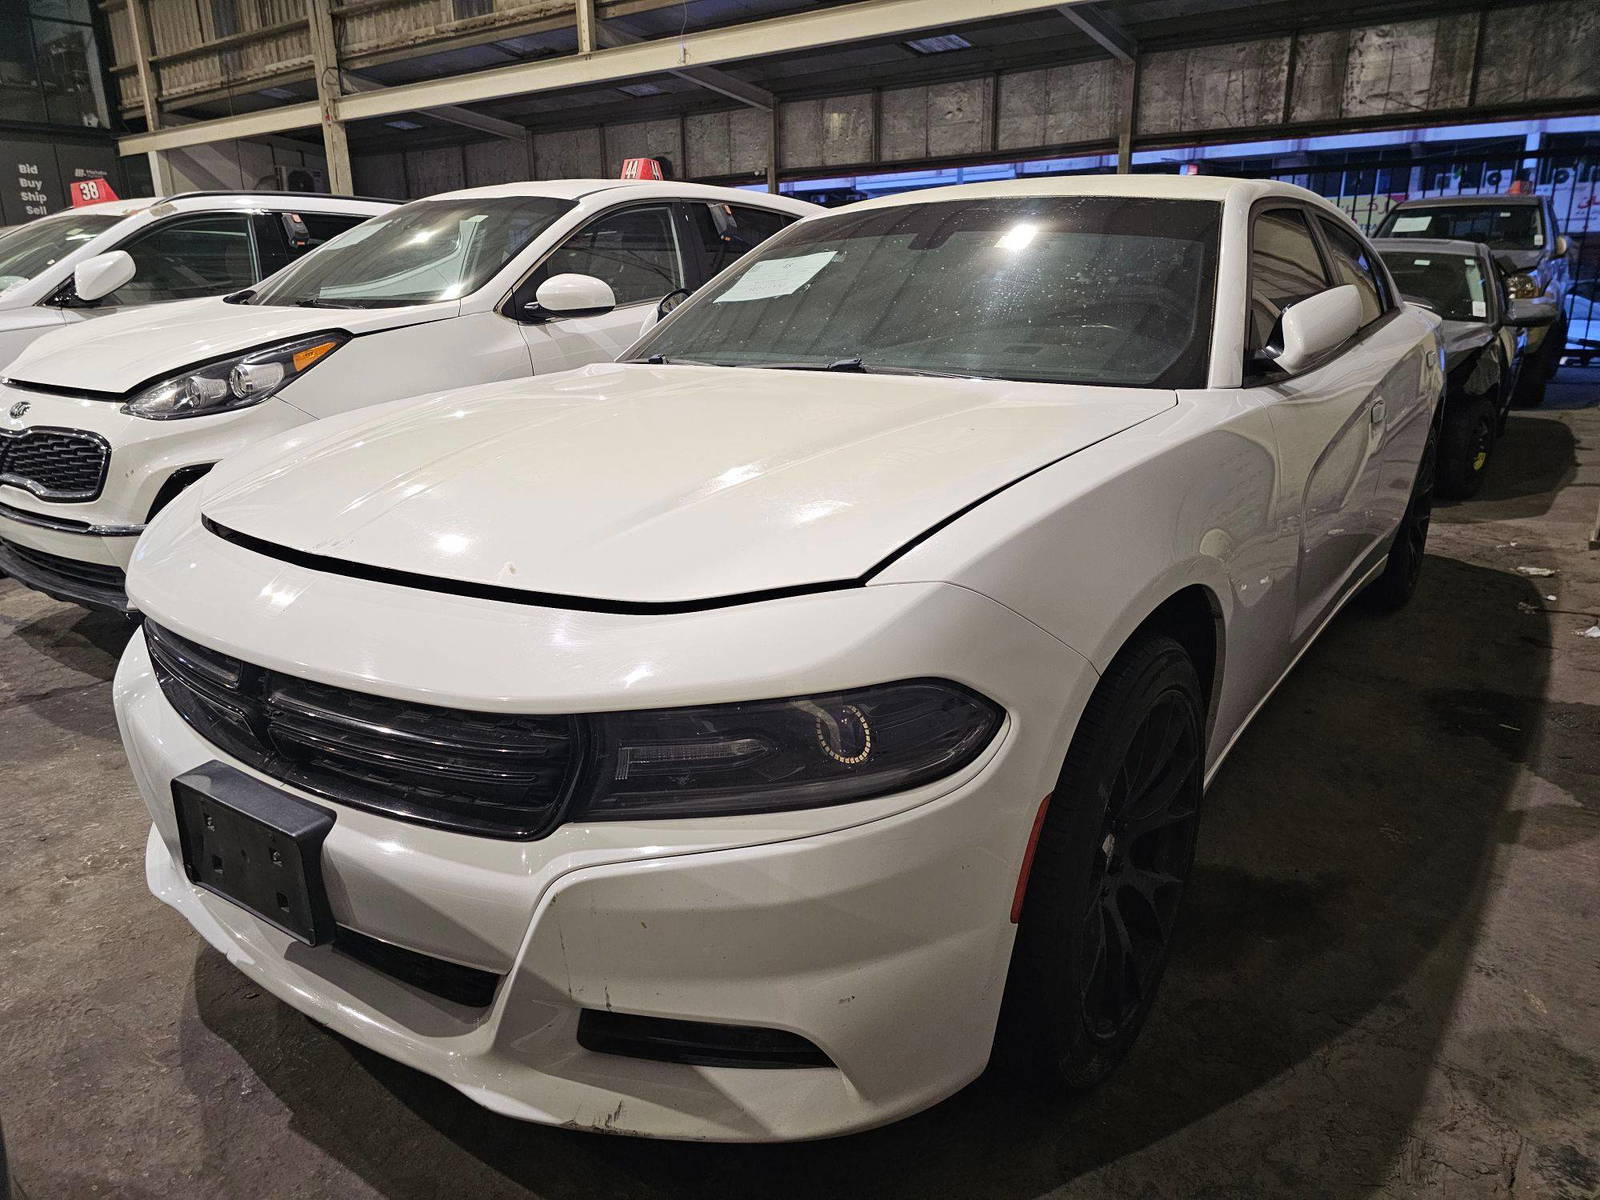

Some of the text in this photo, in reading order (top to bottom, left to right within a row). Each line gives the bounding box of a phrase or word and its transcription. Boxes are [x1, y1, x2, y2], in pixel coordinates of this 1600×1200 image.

[18, 164, 38, 174] Bid
[19, 178, 42, 191] Buy
[80, 182, 99, 200] 38
[21, 192, 47, 204] Ship
[26, 206, 47, 215] Sell
